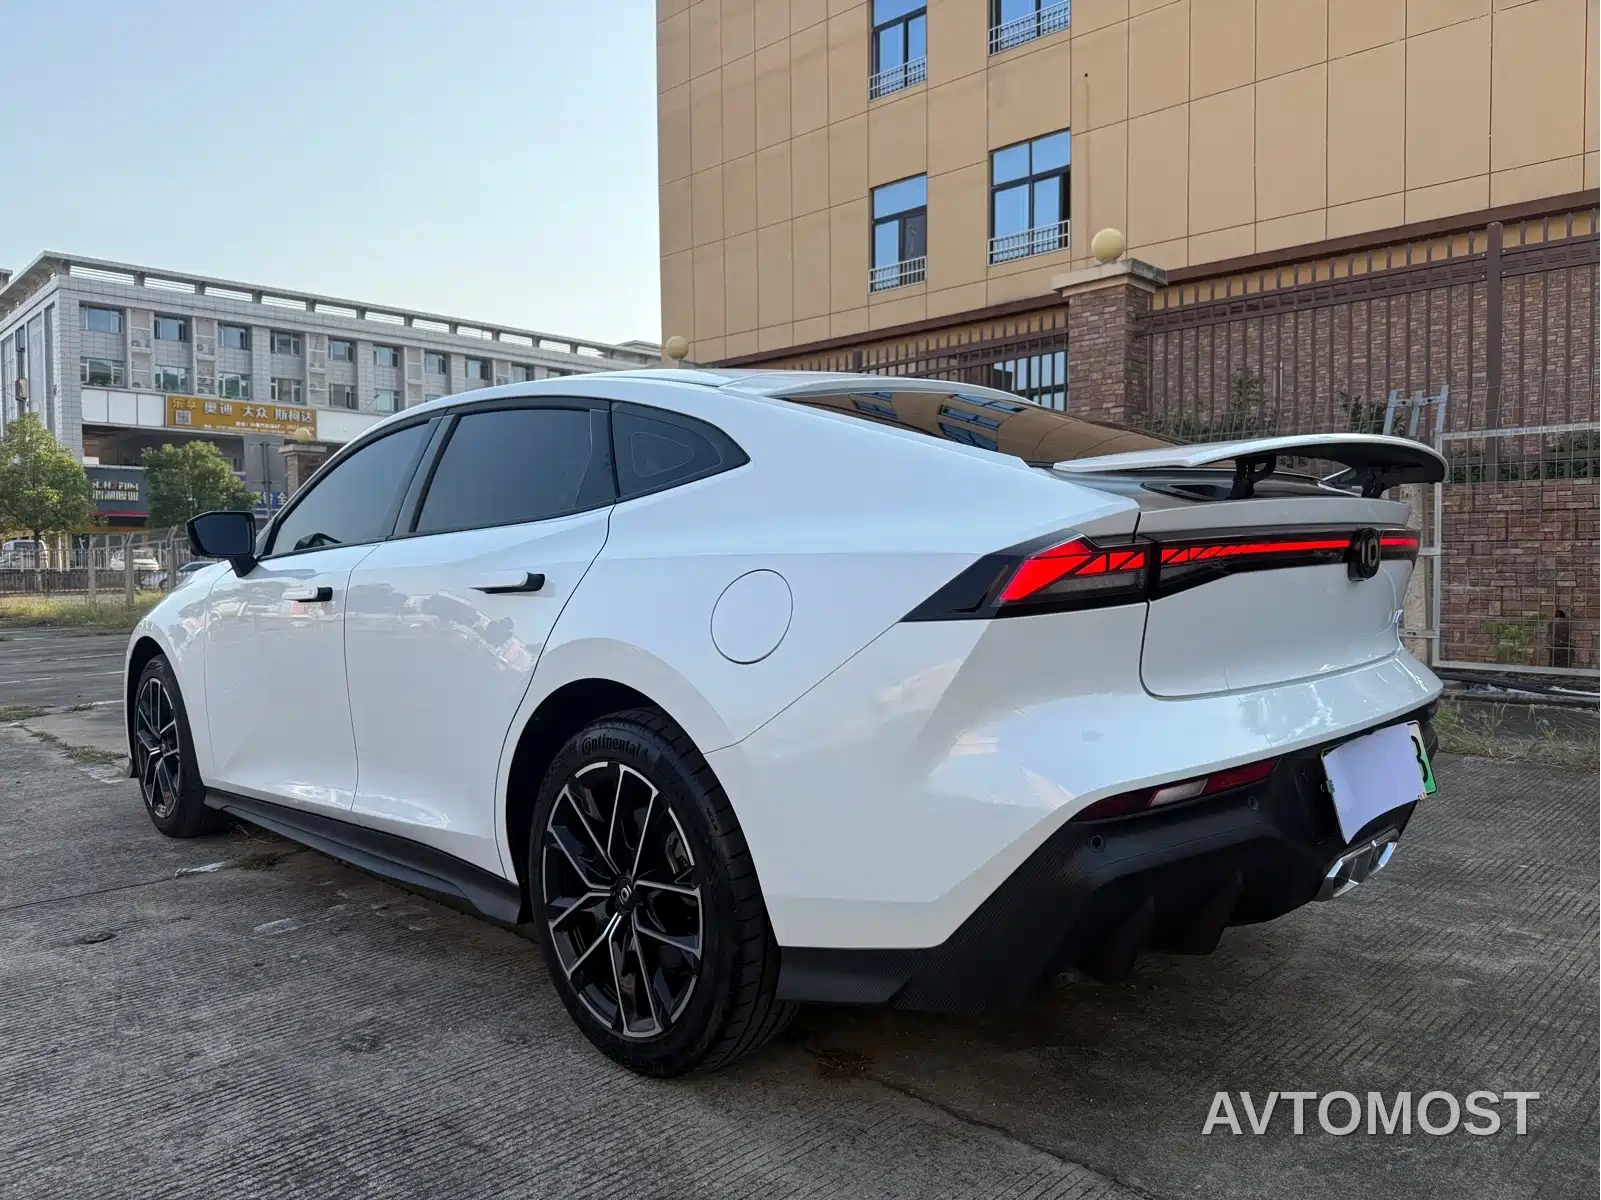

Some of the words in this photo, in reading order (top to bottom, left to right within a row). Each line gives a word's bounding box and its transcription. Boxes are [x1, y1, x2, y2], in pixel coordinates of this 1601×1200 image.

[204, 400, 233, 416] 奥迪
[242, 405, 269, 419] 大众
[274, 408, 313, 423] 斯柯达
[581, 733, 642, 756] Continental
